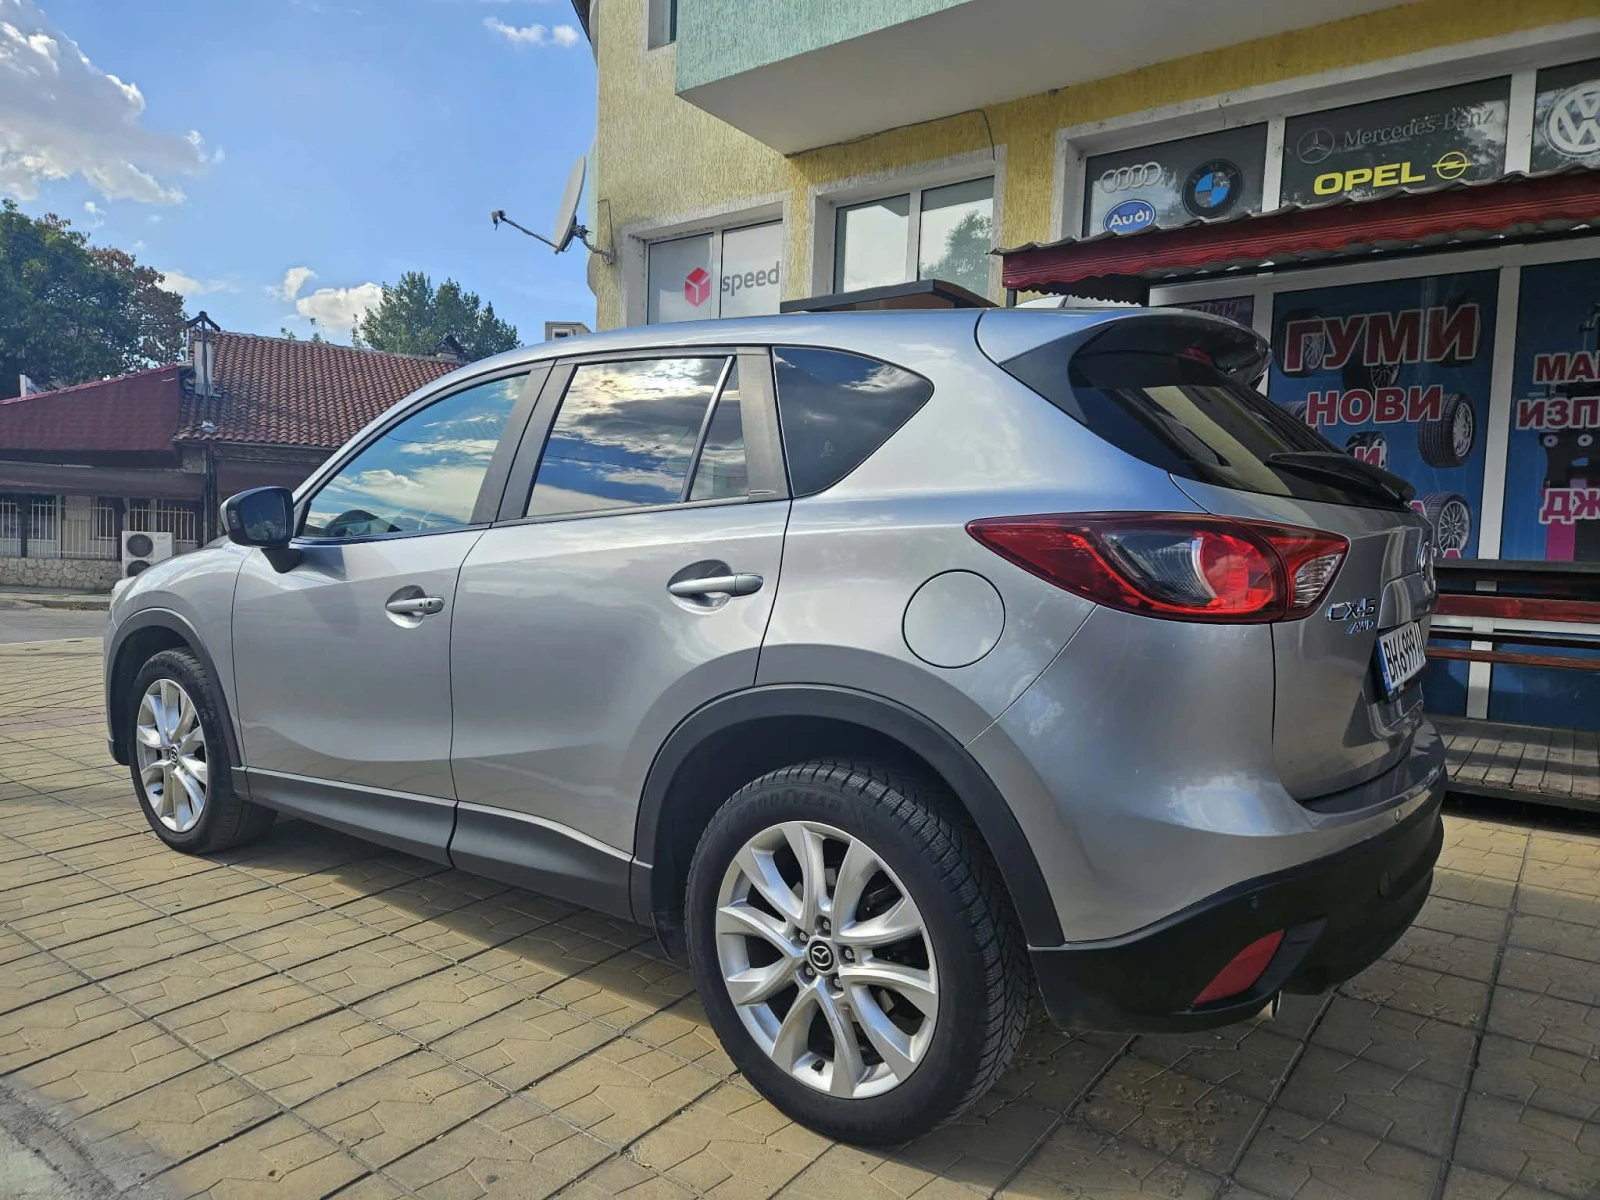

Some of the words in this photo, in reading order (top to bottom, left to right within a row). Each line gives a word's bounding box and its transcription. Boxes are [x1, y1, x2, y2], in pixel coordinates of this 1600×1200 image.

[1343, 107, 1495, 148] Mercedes-Benz
[1313, 162, 1426, 196] OPEL
[1109, 208, 1150, 228] Audi
[722, 260, 780, 296] speed
[1284, 303, 1481, 373] ГУМИ
[1533, 350, 1600, 384] МА
[1305, 384, 1444, 426] НОВИ
